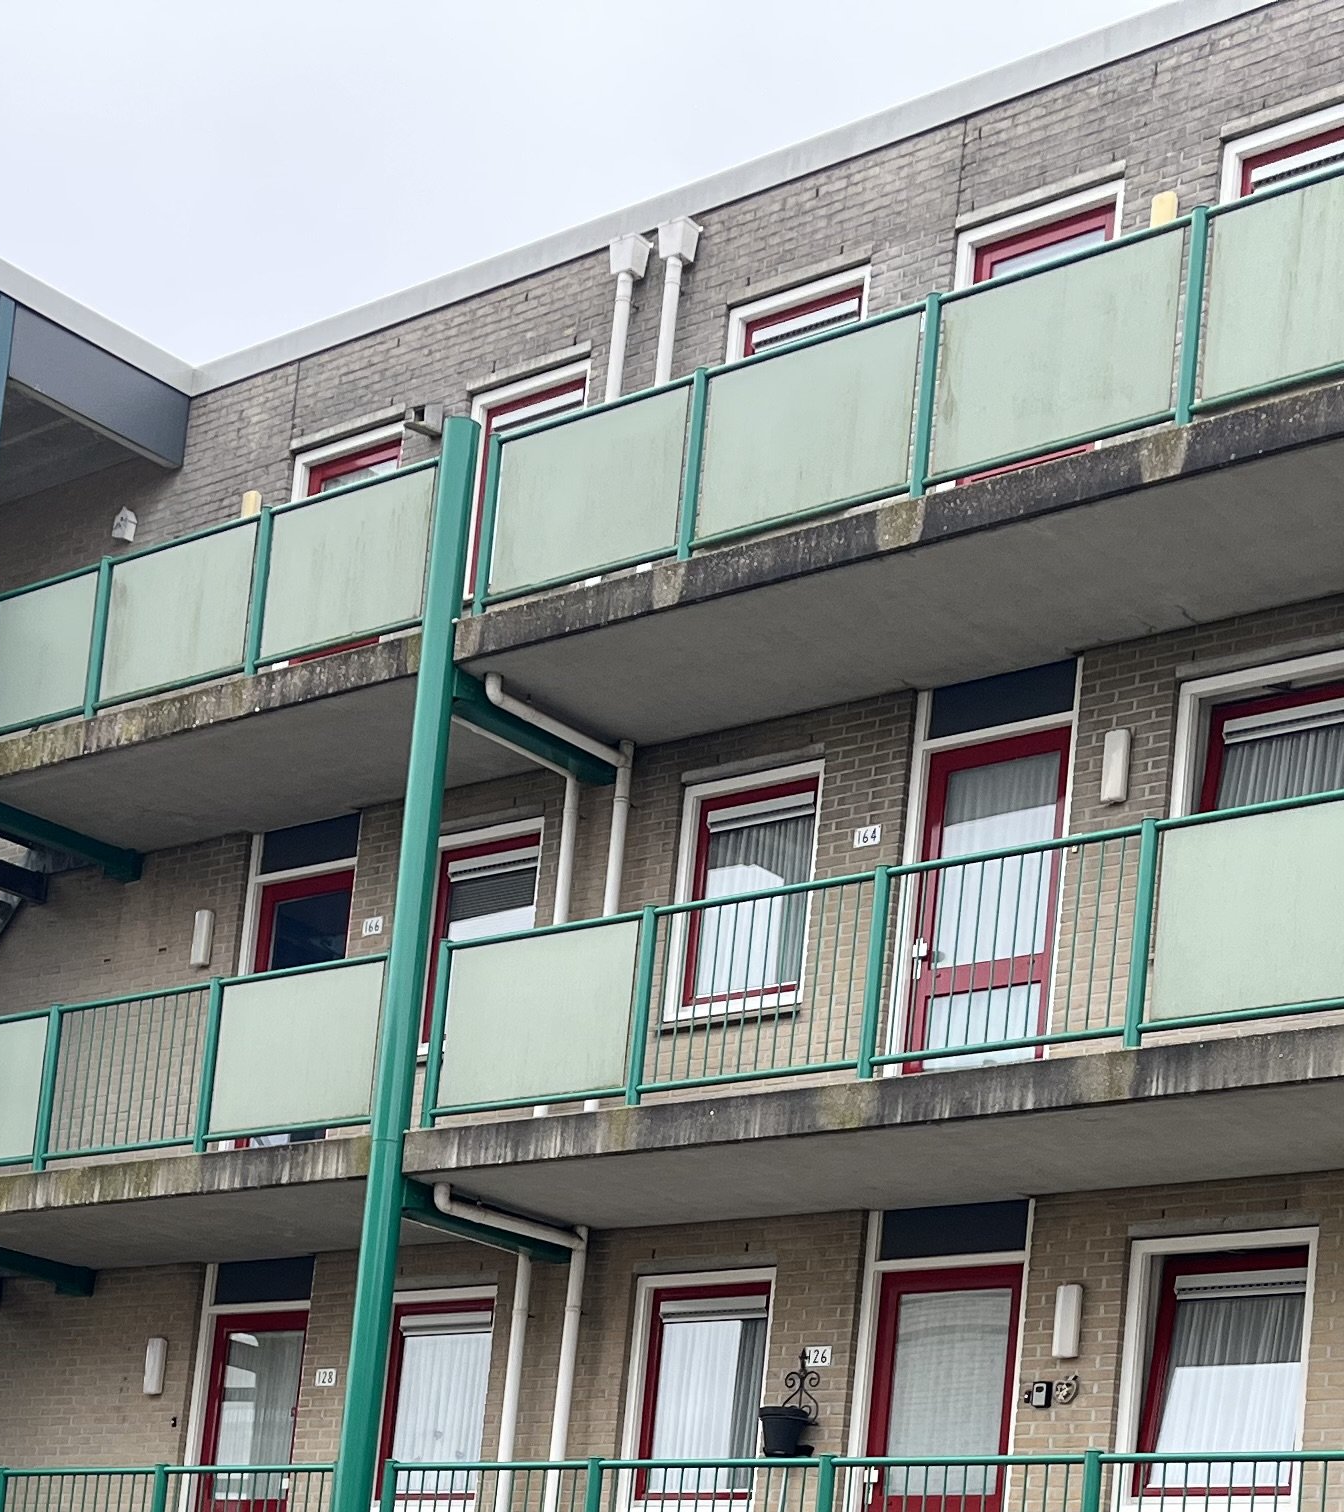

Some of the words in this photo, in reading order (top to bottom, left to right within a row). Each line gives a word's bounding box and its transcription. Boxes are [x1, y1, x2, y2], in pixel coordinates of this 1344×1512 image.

[857, 827, 878, 846] 164
[364, 919, 381, 935] 166
[807, 1348, 829, 1365] 126
[317, 1370, 335, 1385] 128
